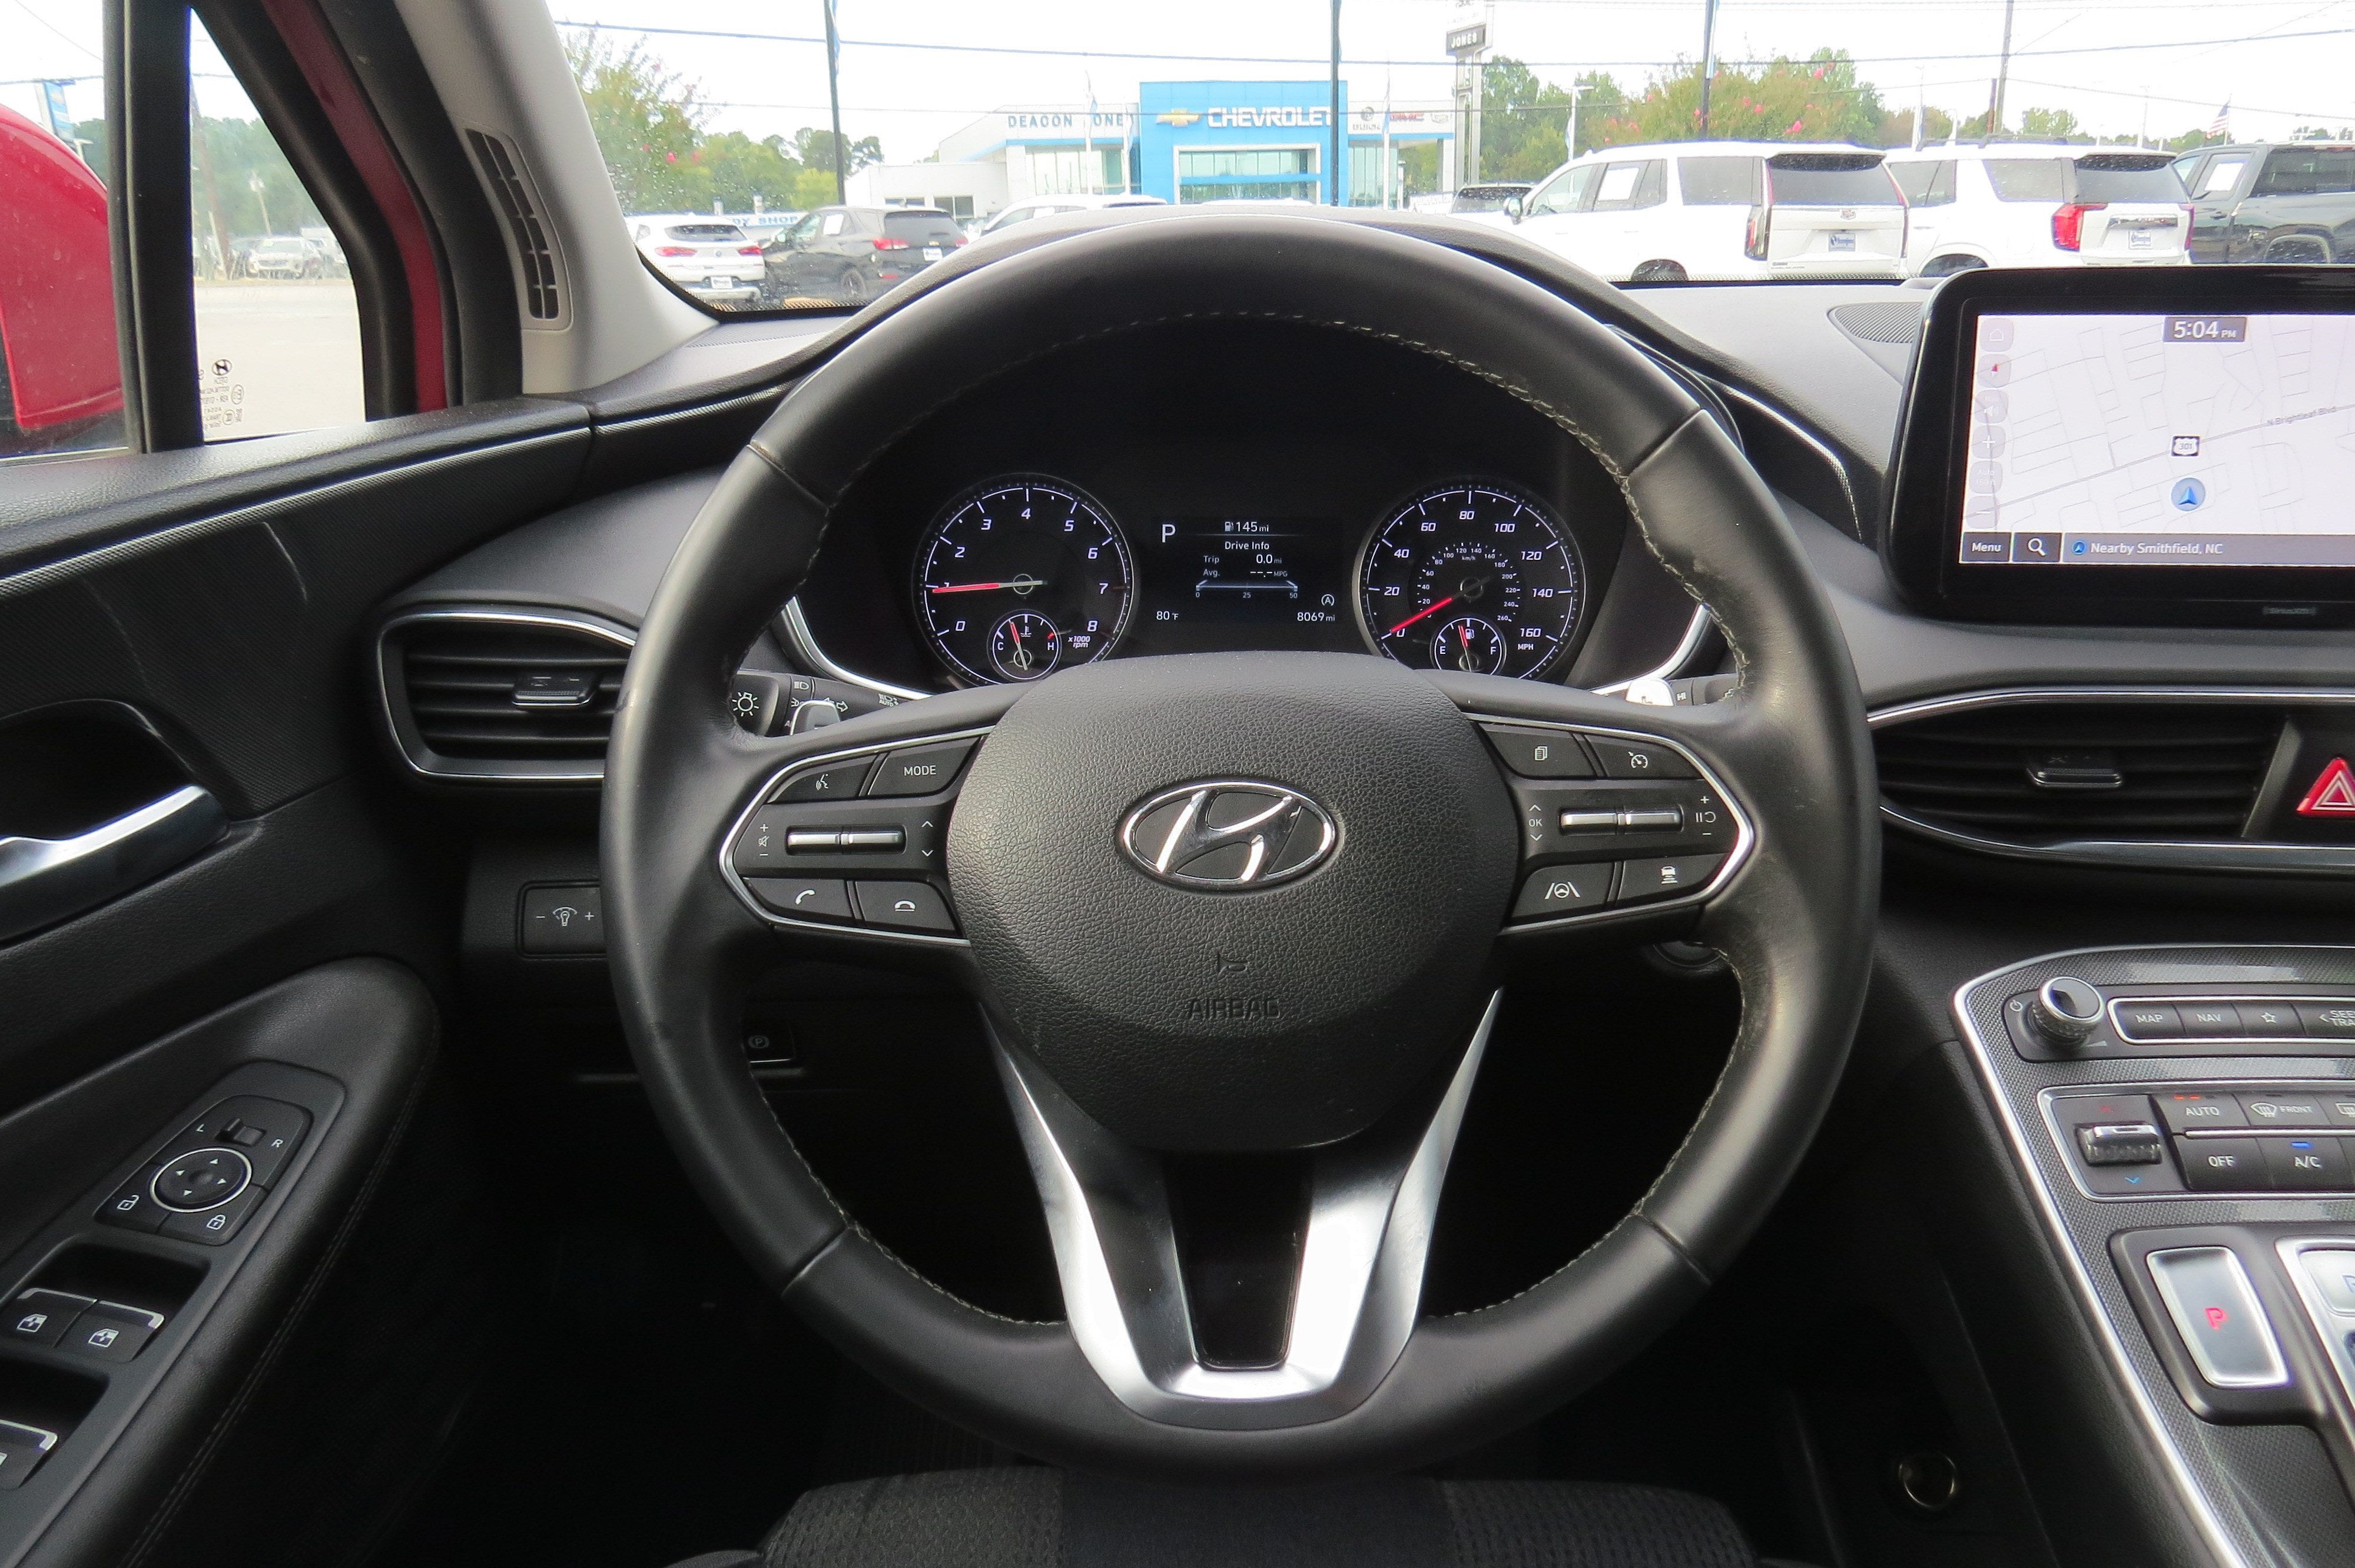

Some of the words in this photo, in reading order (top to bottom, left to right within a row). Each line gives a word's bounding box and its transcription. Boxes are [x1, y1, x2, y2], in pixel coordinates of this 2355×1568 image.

[1008, 115, 1073, 128] DEACON
[1207, 106, 1331, 128] CHEVROLET
[758, 216, 798, 225] SHOP
[2173, 320, 2219, 338] 5:04
[2221, 329, 2236, 338] PM
[1021, 508, 1031, 519] 4
[1458, 510, 1475, 520] 80
[981, 519, 991, 530] 3
[1064, 520, 1074, 531] 5
[1236, 521, 1258, 532] 145
[1259, 524, 1269, 532] mi
[1420, 523, 1437, 531] 60
[1494, 523, 1515, 533] 100
[1162, 523, 1176, 543] P
[1225, 541, 1249, 550] Drive
[1252, 541, 1270, 550] Info
[1971, 542, 2002, 553] Menu
[2091, 542, 2134, 556] Nearby
[2136, 542, 2202, 555] Smithfield,
[2205, 543, 2223, 554] NC
[954, 547, 966, 558] 2
[1087, 547, 1099, 559] 6
[1393, 549, 1409, 558] 40
[1520, 551, 1543, 560] 120
[1203, 555, 1220, 564] Trip
[1256, 554, 1273, 564] 0.0
[1203, 569, 1220, 577] Avg.
[1099, 583, 1109, 594] 7
[1384, 587, 1400, 596] 20
[1532, 588, 1553, 598] 140
[1156, 610, 1170, 620] 80
[1296, 612, 1325, 622] 8069
[955, 620, 966, 632] 0
[1087, 620, 1098, 632] 8
[1520, 627, 1542, 637] 160
[1067, 635, 1091, 643] x1000
[997, 642, 1004, 651] C
[1047, 642, 1054, 651] H
[1439, 646, 1446, 655] E
[1490, 646, 1497, 655] F
[1676, 692, 1686, 702] HI
[904, 765, 937, 777] MODE
[1528, 818, 1543, 827] OK
[1189, 999, 1281, 1020] AIRBAG
[2135, 1013, 2164, 1024] MAP
[2196, 1013, 2222, 1023] NAV
[2185, 1106, 2220, 1117] AUTO
[2279, 1105, 2313, 1114] FRONT
[195, 1123, 205, 1132] L
[270, 1138, 284, 1148] R
[2208, 1155, 2235, 1168] OFF
[2294, 1155, 2323, 1169] A/C
[2204, 1307, 2229, 1331] P
